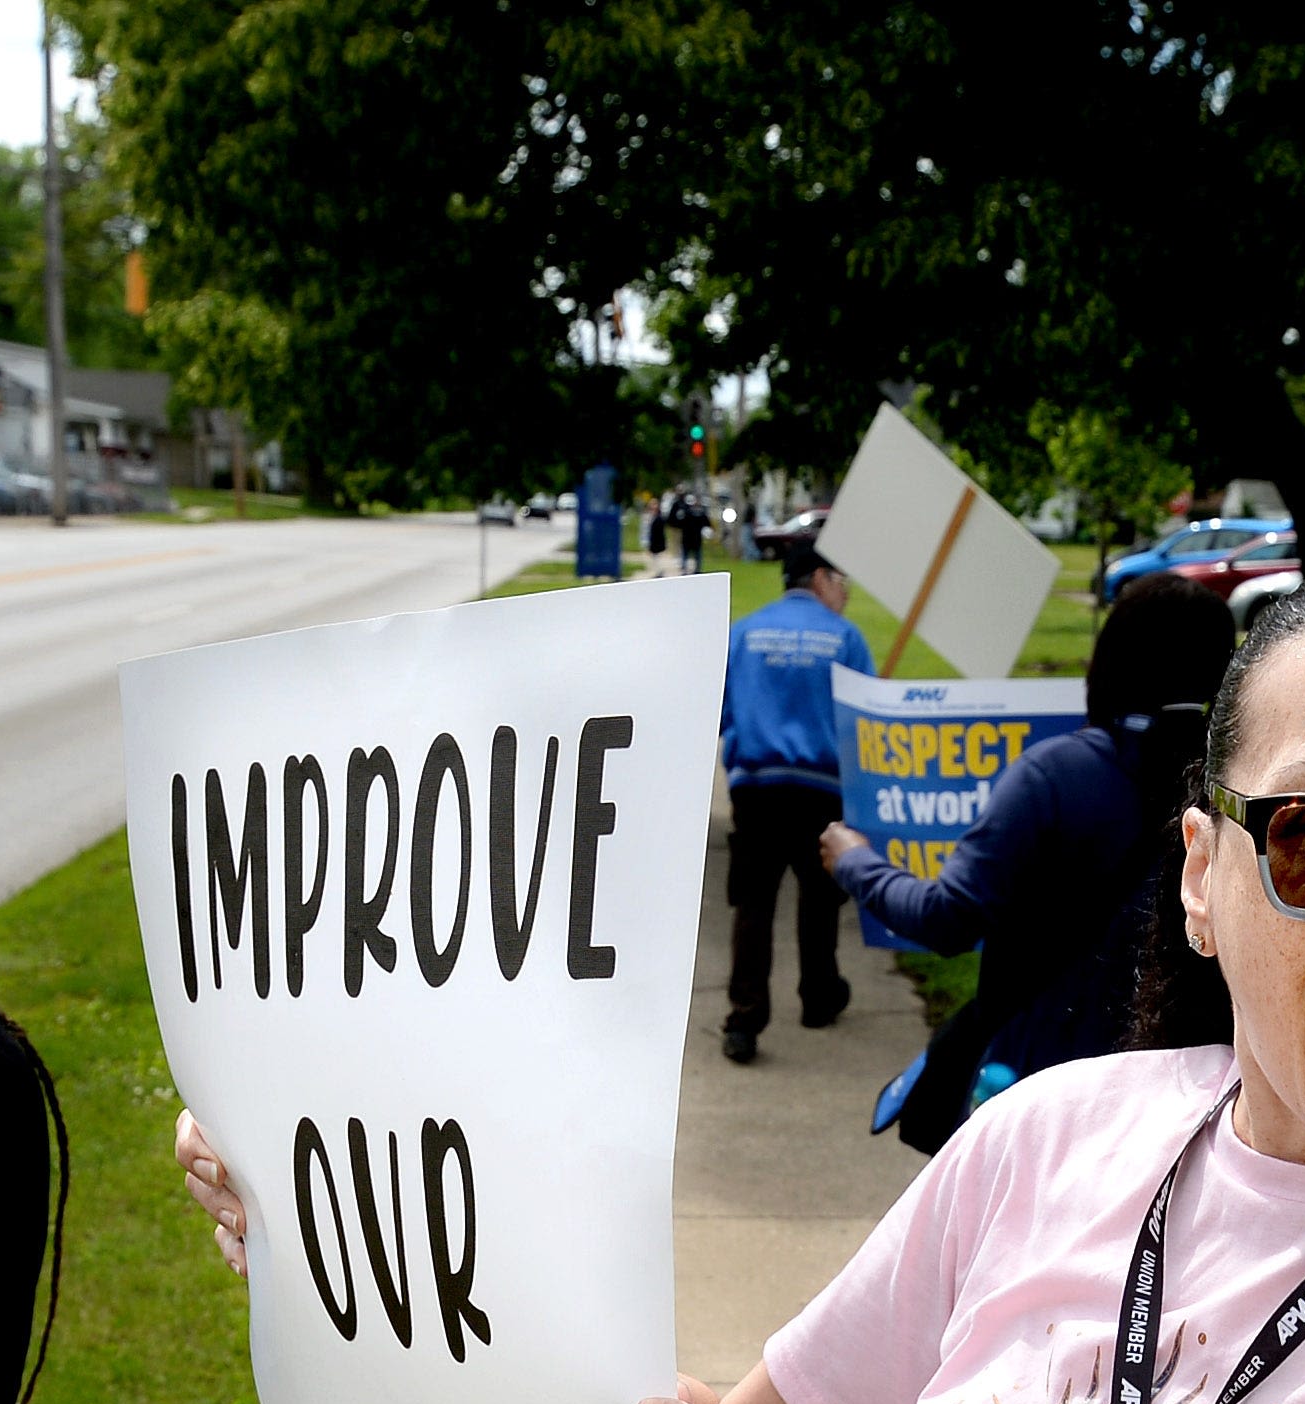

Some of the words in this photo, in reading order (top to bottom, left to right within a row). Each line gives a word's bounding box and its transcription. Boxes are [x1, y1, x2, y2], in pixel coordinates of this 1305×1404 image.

[856, 717, 1032, 778] RESPECT
[876, 784, 907, 824] at
[171, 716, 634, 1003] IMPROVE
[887, 838, 957, 882] SAF
[1135, 1249, 1157, 1296] UNION
[1125, 1297, 1151, 1364] MEMBER
